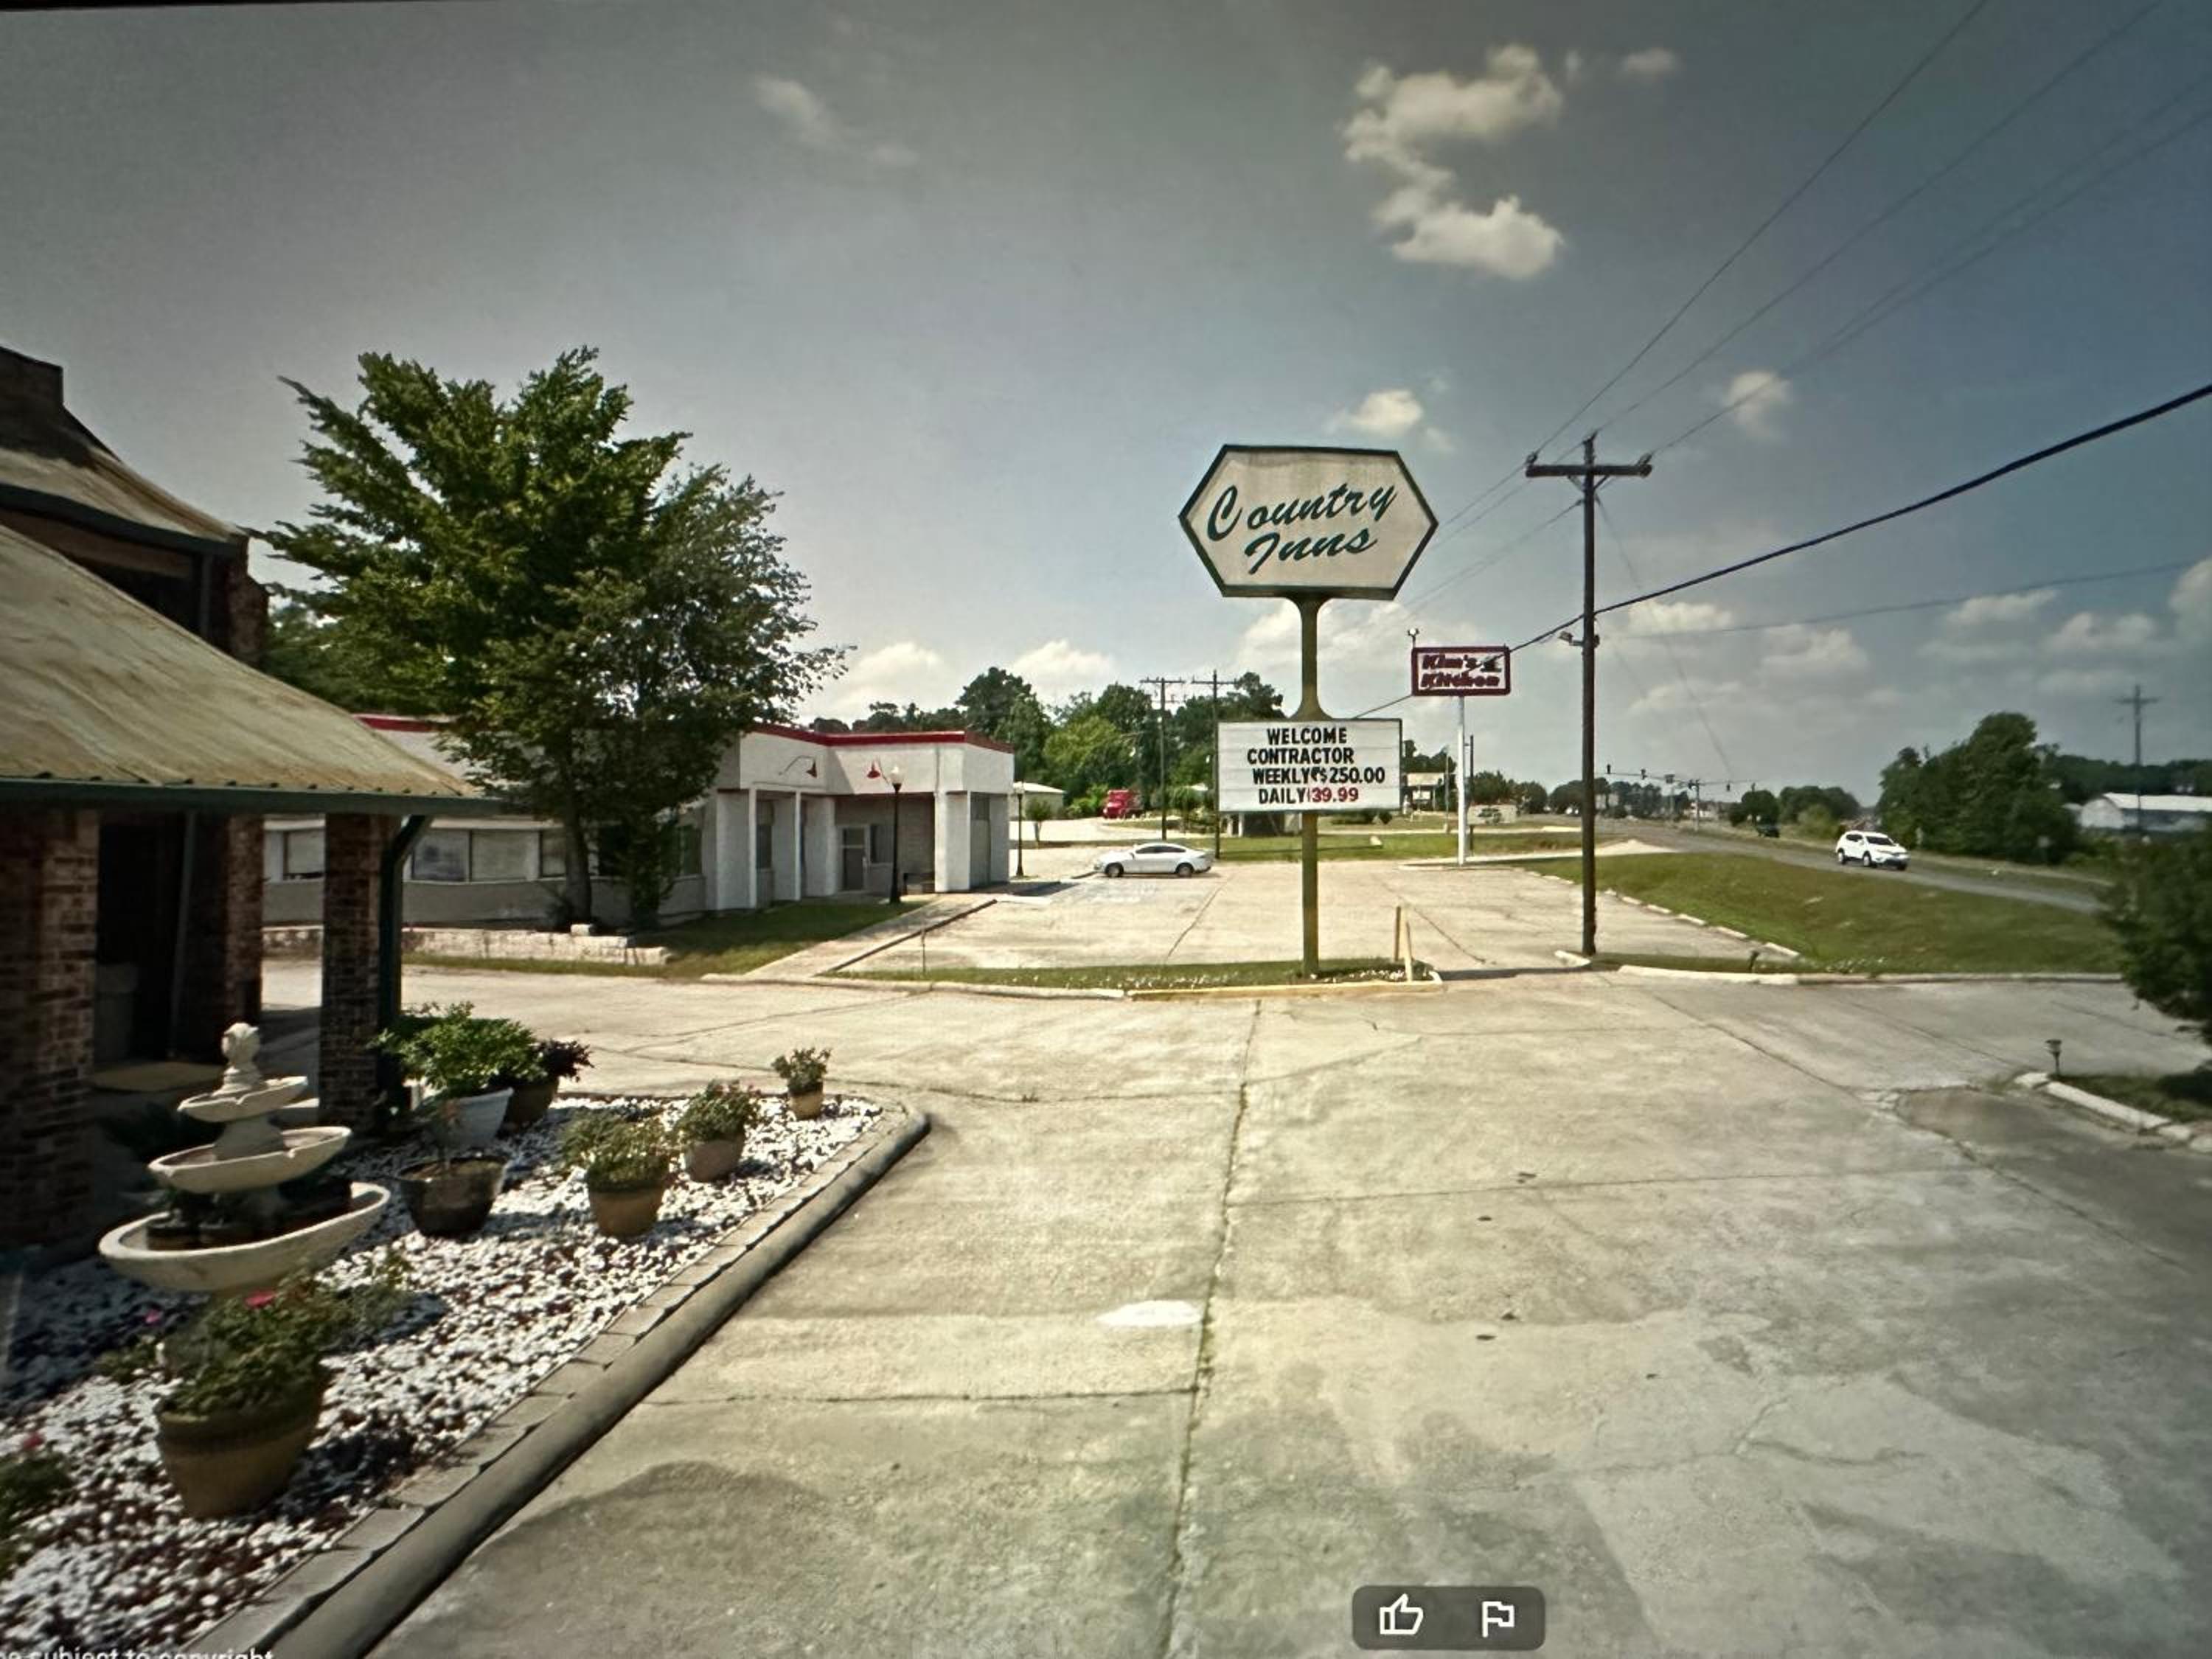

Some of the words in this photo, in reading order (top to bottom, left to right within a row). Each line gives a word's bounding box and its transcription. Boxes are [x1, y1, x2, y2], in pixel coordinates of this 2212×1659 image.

[1207, 483, 1398, 542] Country
[1244, 527, 1378, 574] Inns
[1420, 671, 1500, 687] Kitchen
[1267, 727, 1348, 745] WELCOME
[1247, 746, 1355, 765] CONTRACTOR
[1259, 787, 1306, 804] DAILY
